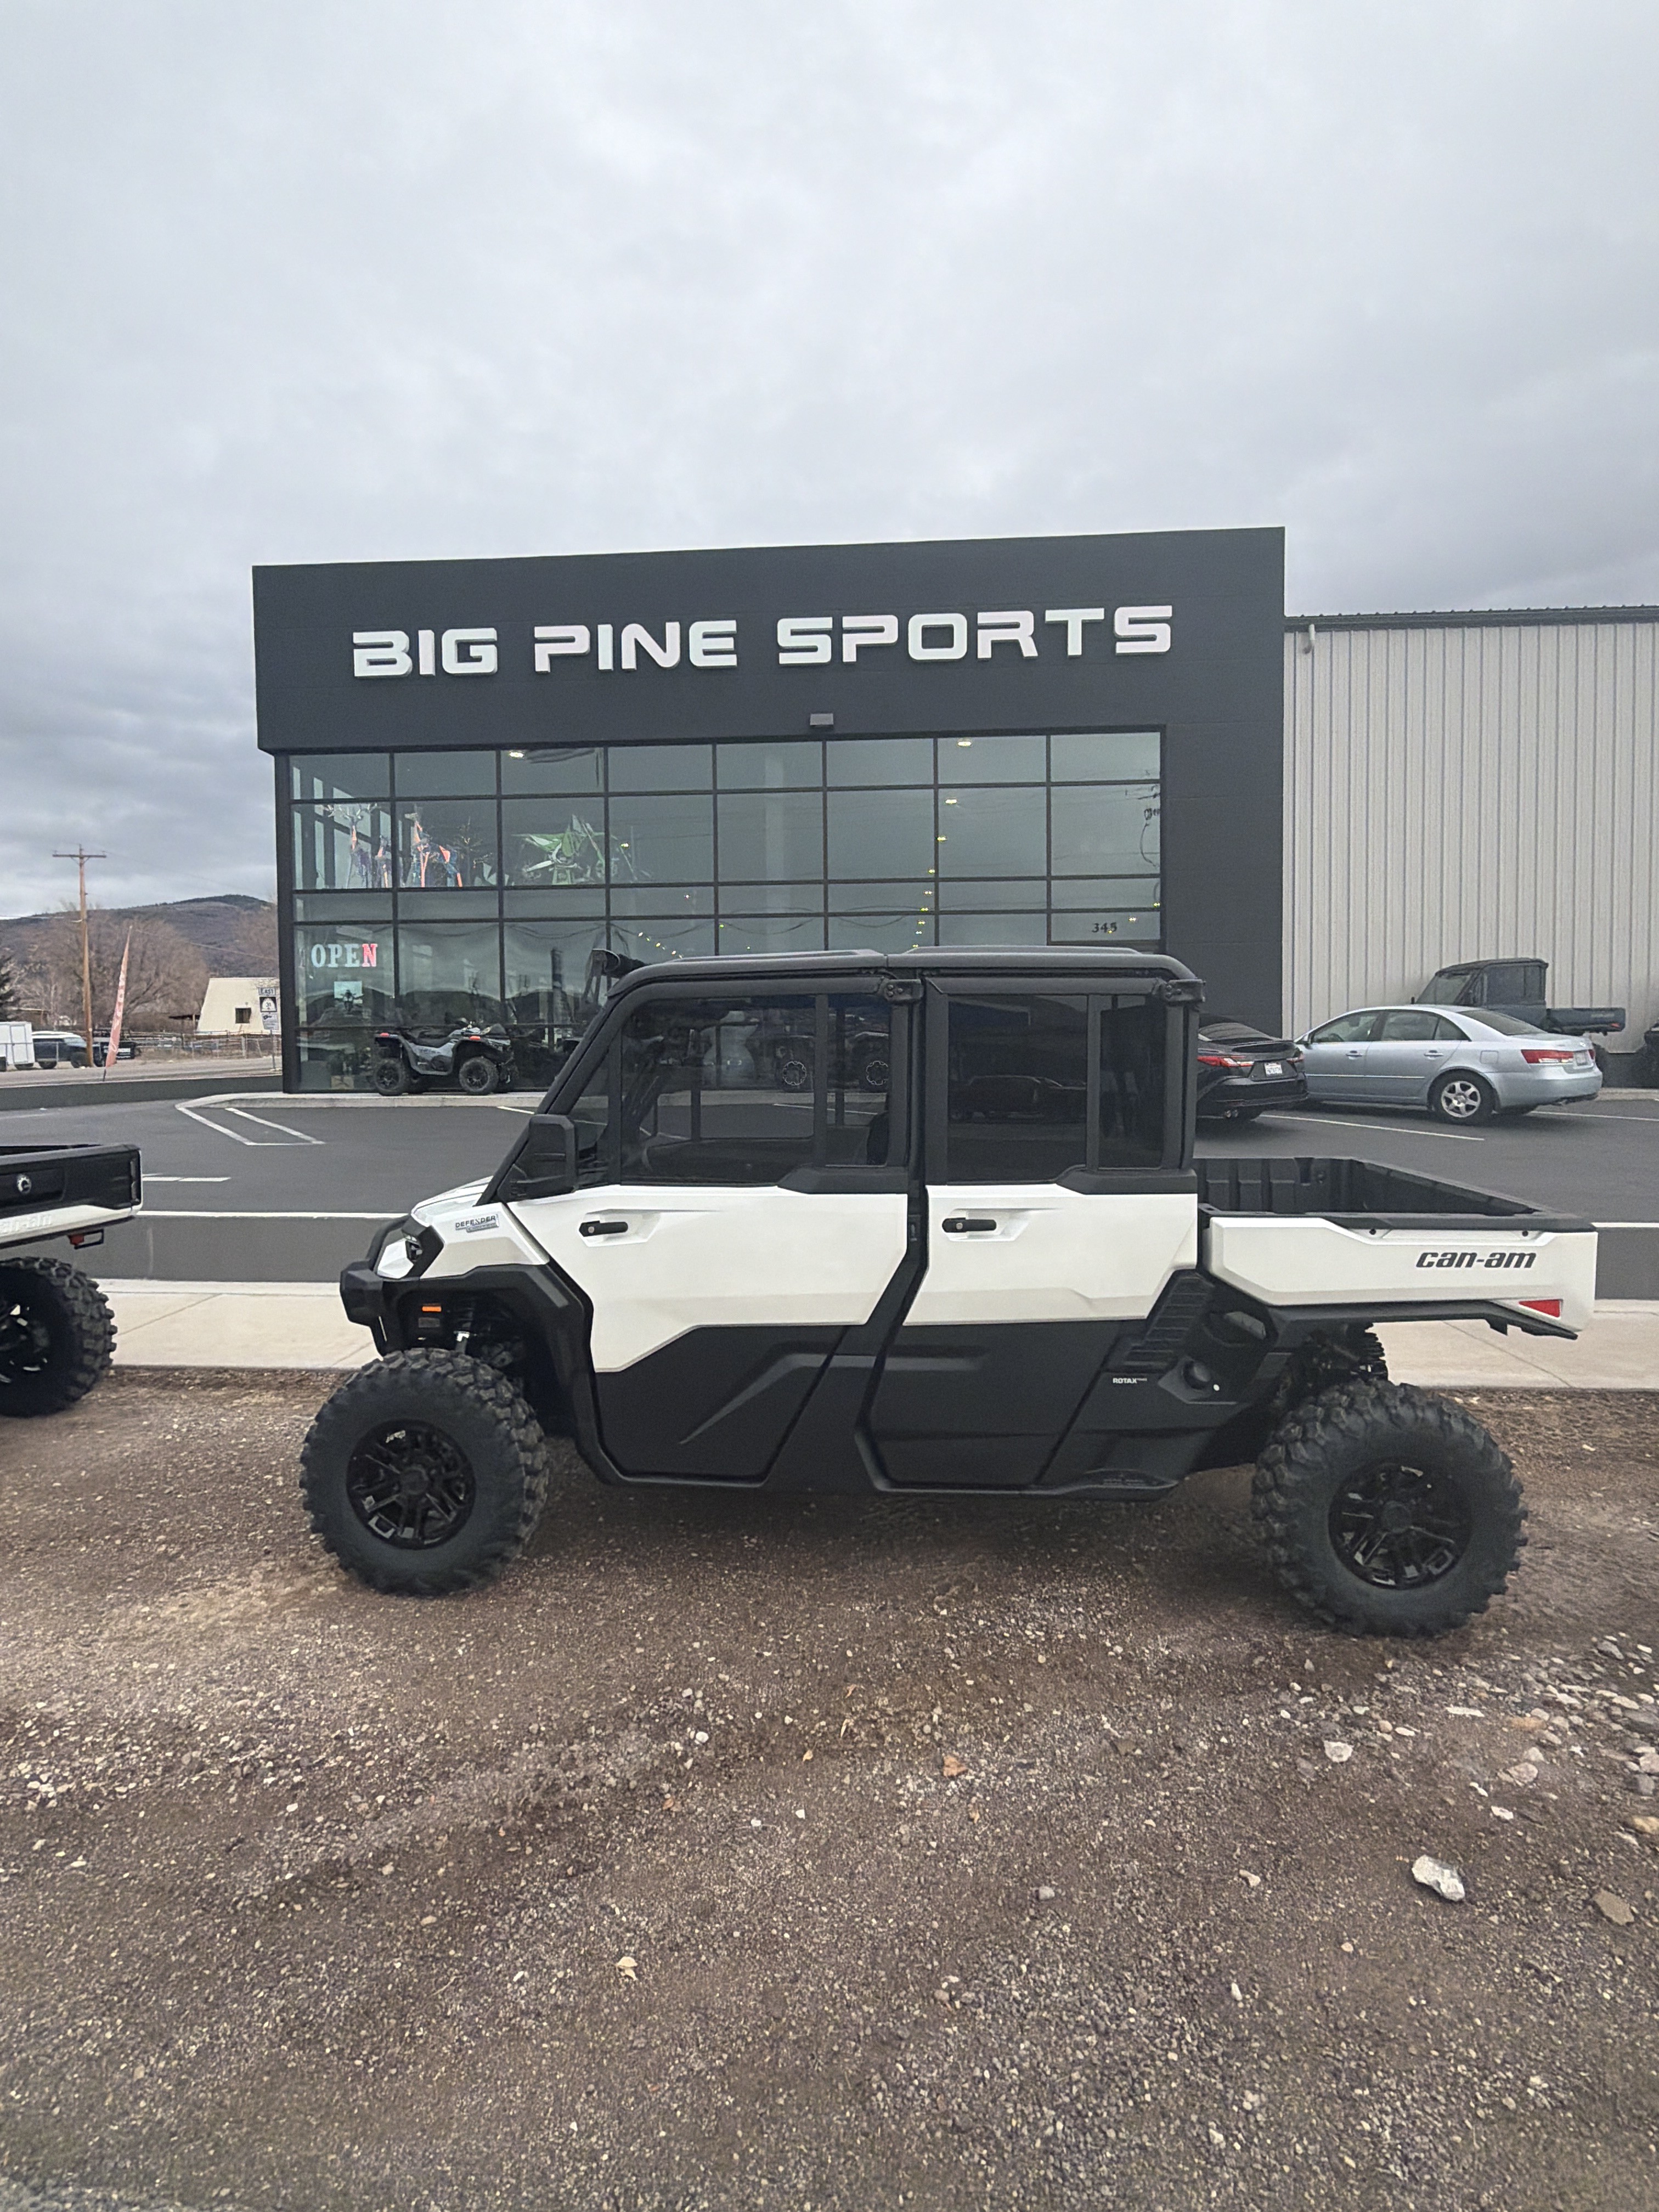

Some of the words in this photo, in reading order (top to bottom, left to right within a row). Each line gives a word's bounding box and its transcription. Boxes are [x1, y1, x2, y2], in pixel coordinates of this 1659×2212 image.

[353, 627, 498, 678] BIG
[534, 620, 737, 673] PINE
[777, 605, 1173, 665] SPORTS
[1092, 922, 1117, 933] 345
[311, 943, 378, 968] OPEN
[455, 1215, 496, 1228] DEFENDER
[1415, 1252, 1537, 1268] can-am
